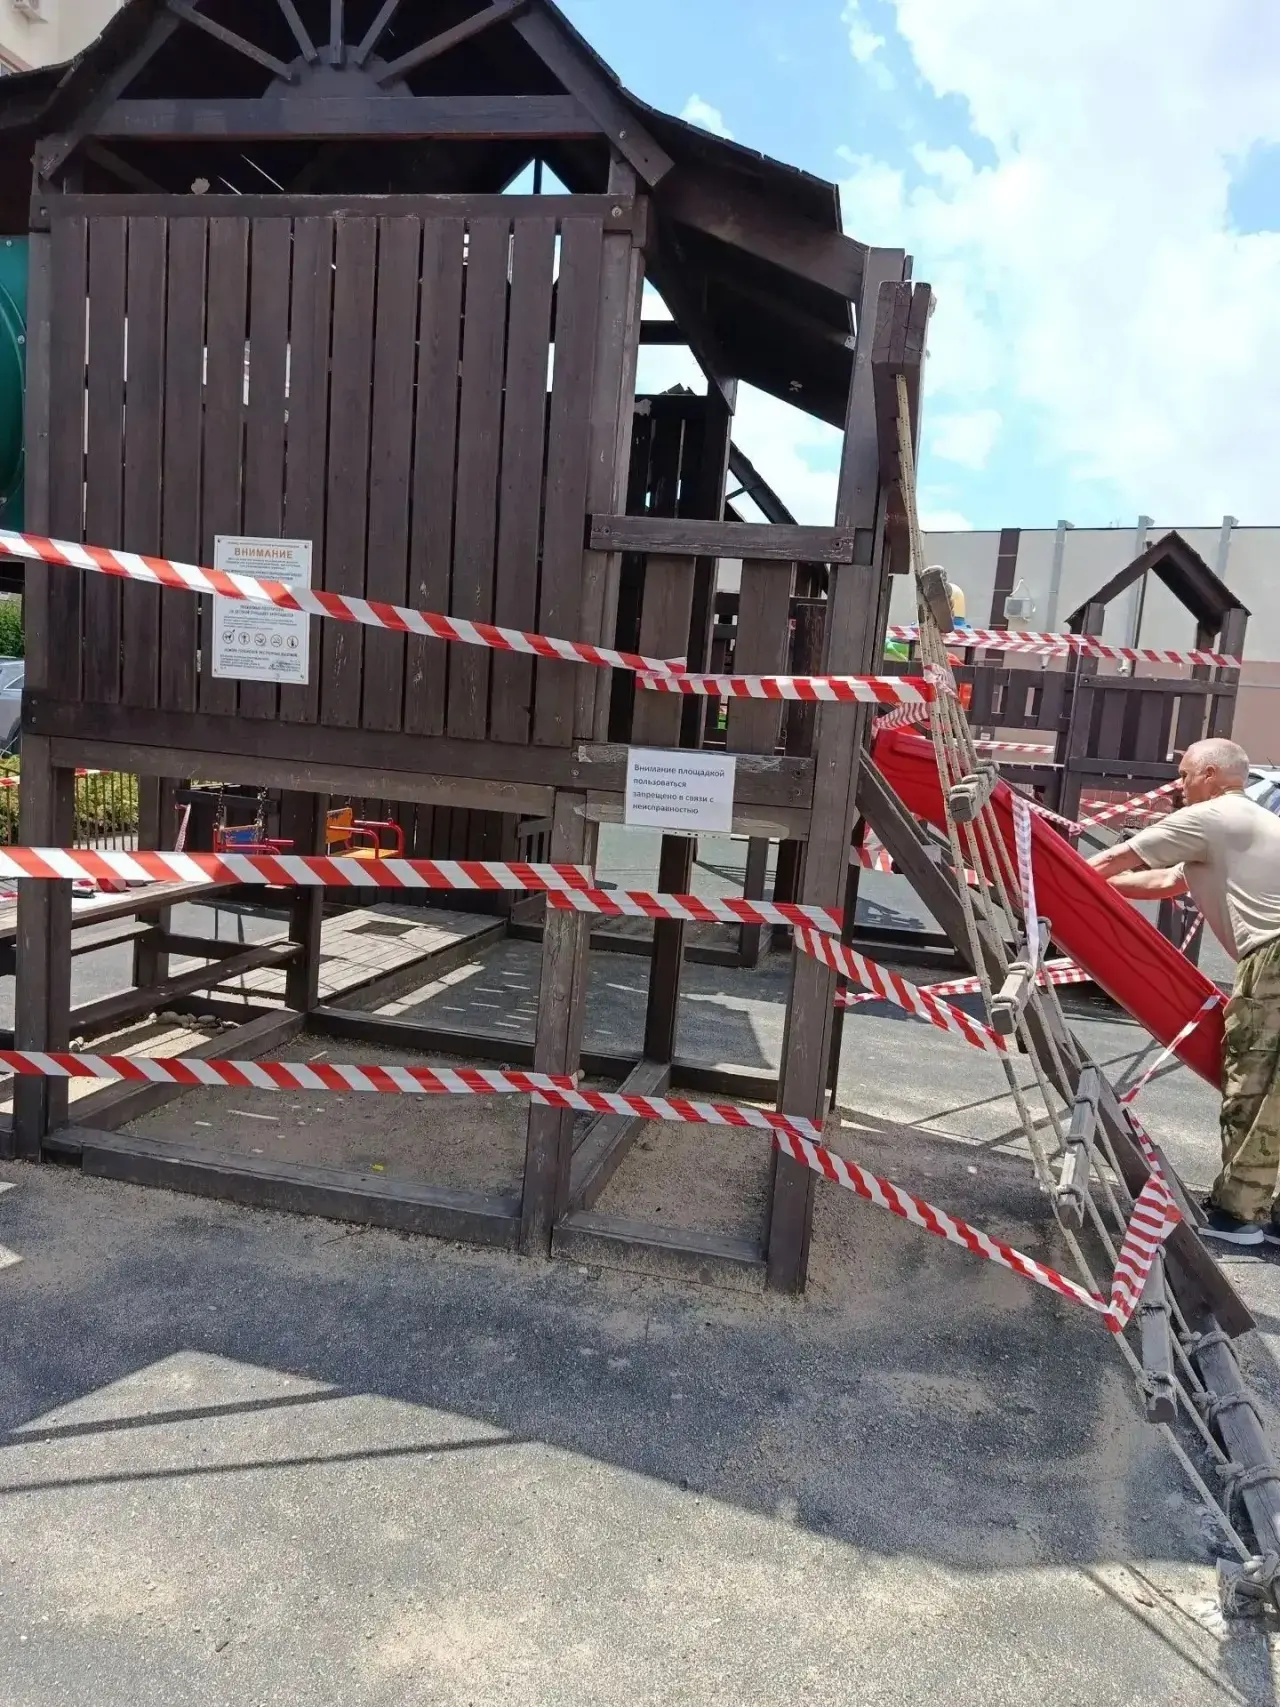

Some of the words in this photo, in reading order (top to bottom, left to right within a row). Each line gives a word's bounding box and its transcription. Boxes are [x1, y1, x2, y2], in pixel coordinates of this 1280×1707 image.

[234, 548, 293, 559] ВНИМАНИЕ
[634, 764, 676, 774] Внимание
[678, 768, 725, 778] площадкой
[633, 778, 687, 788] пользоваться
[632, 791, 677, 801] запрещено
[632, 804, 699, 814] неисправностью
